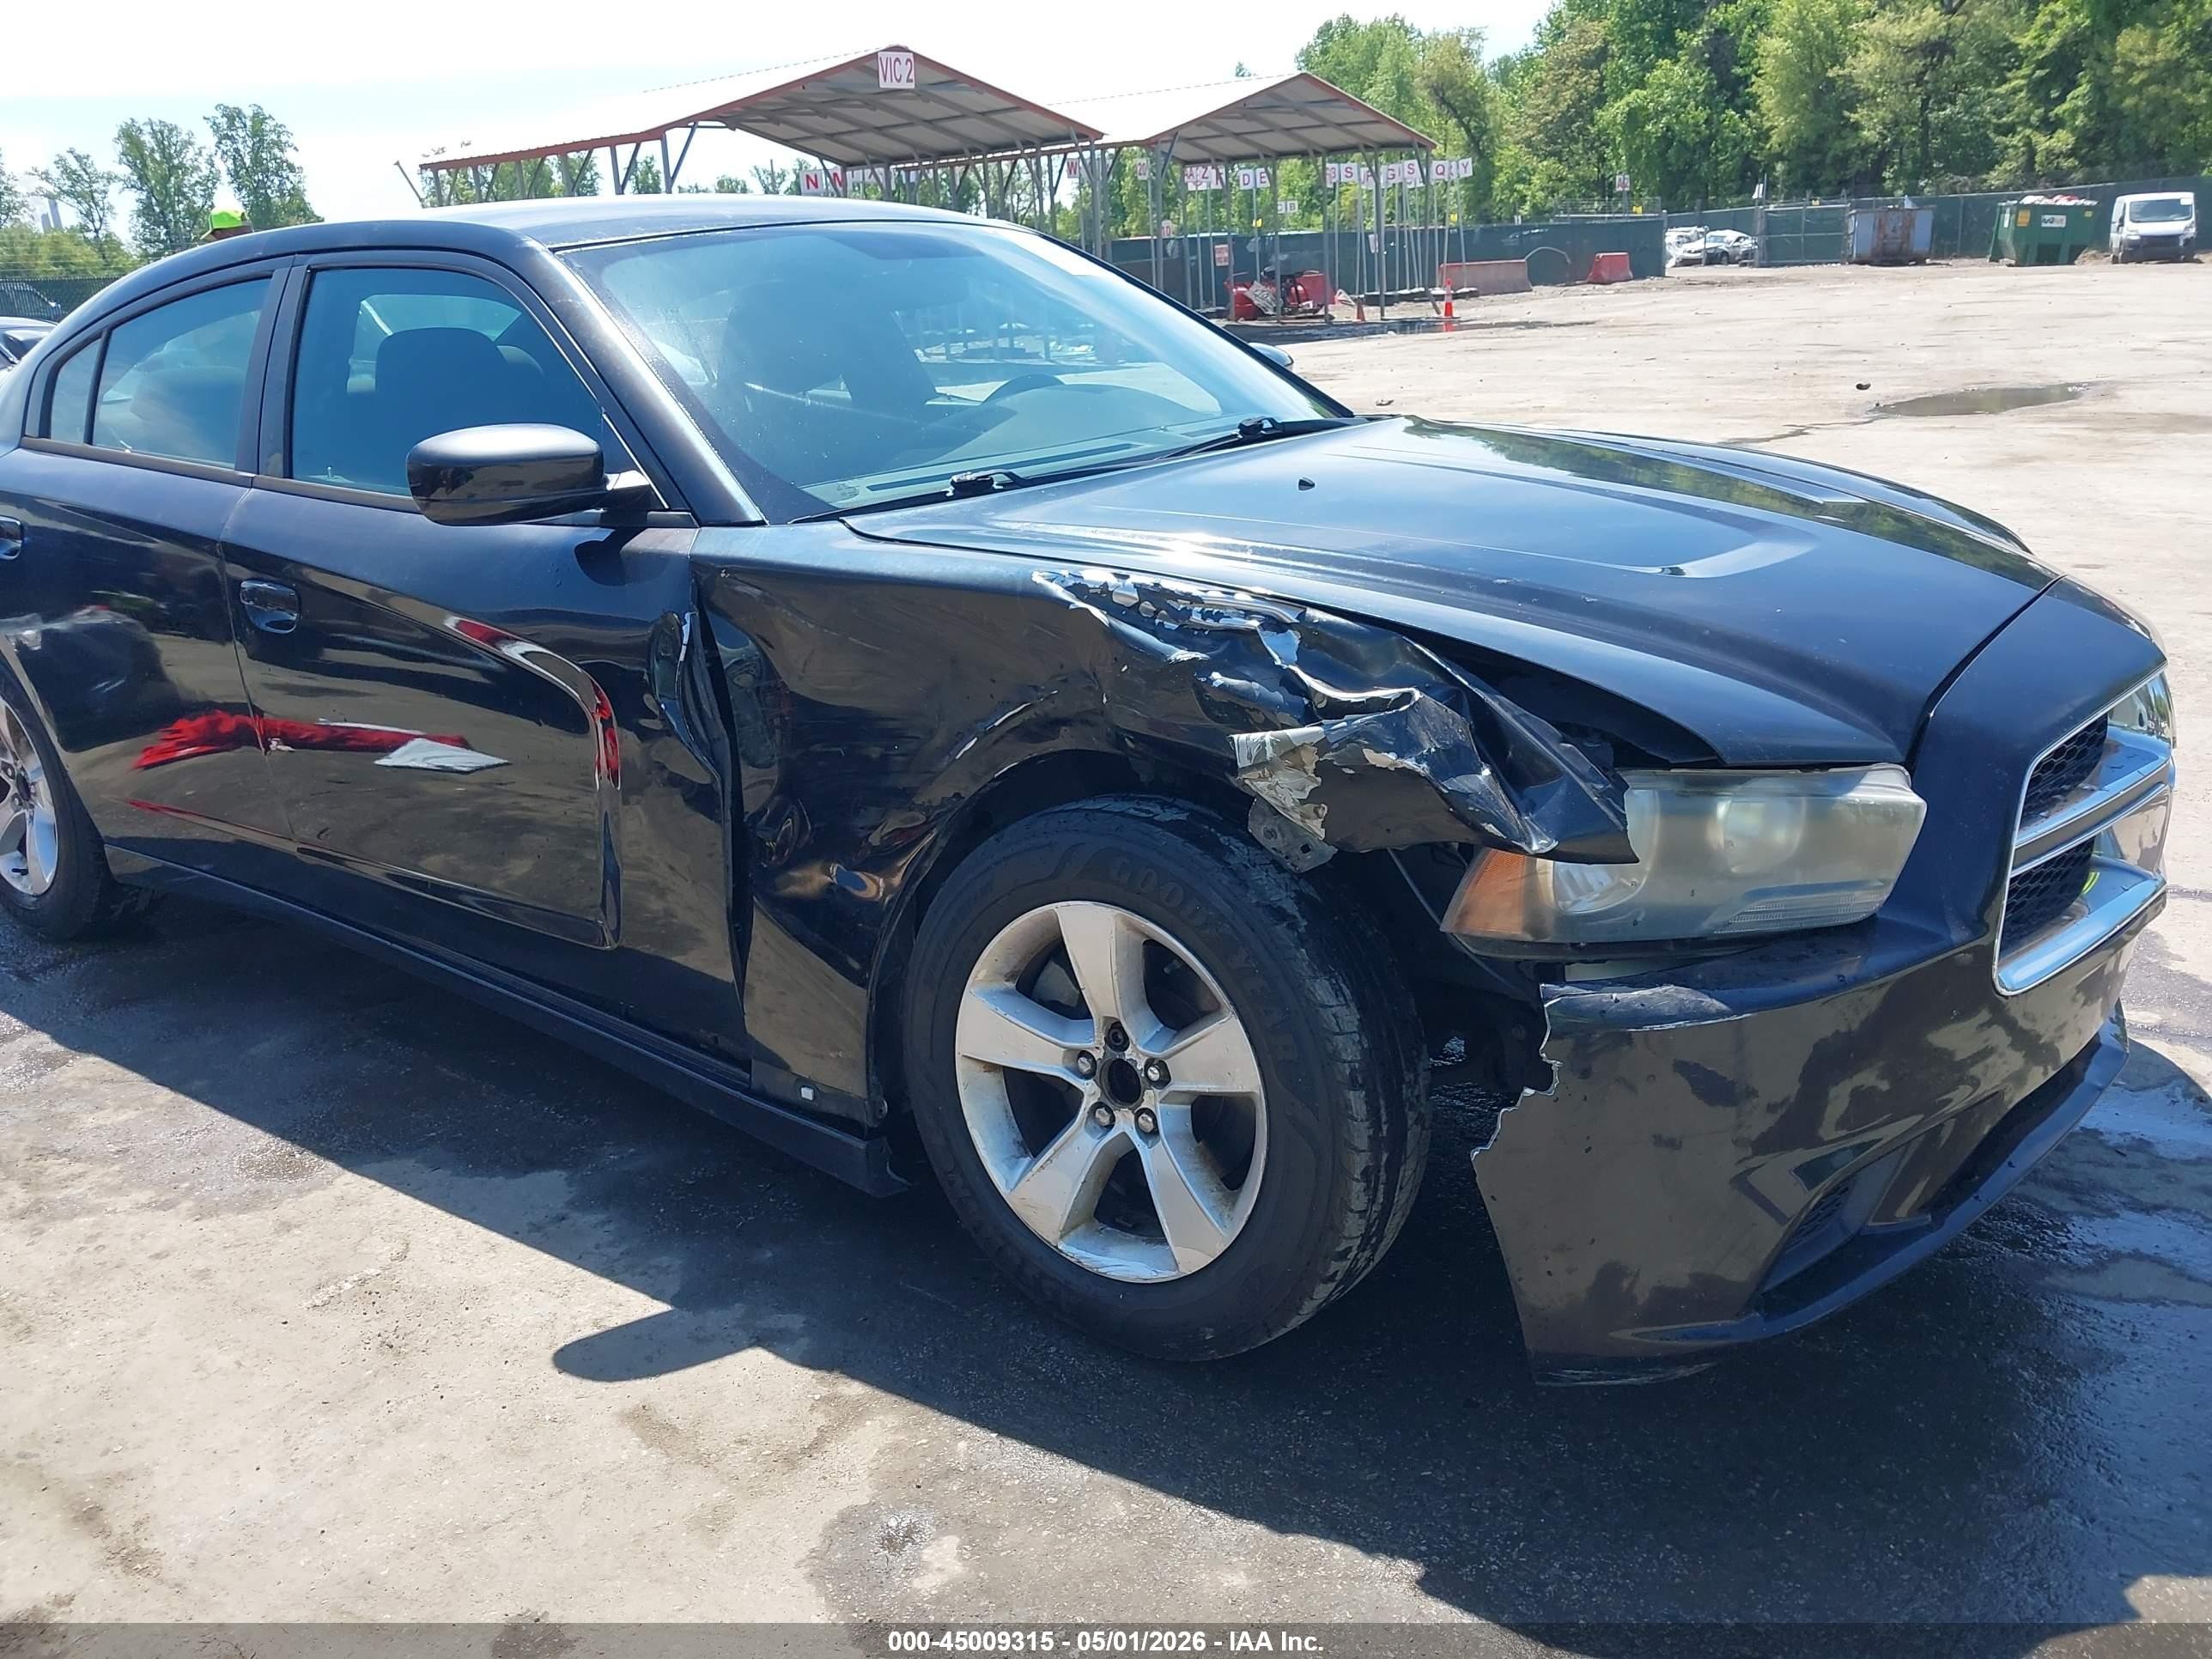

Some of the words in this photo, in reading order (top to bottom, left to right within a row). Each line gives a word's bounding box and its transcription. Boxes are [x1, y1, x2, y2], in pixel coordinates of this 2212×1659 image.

[879, 57, 902, 83] VIC
[905, 58, 914, 83] 2
[1066, 161, 1079, 176] W
[1345, 167, 1354, 179] S
[1407, 163, 1415, 175] S
[1435, 164, 1446, 176] Q
[1461, 161, 1470, 173] Y
[805, 173, 818, 190] N
[1243, 173, 1250, 185] D
[1260, 172, 1267, 184] E
